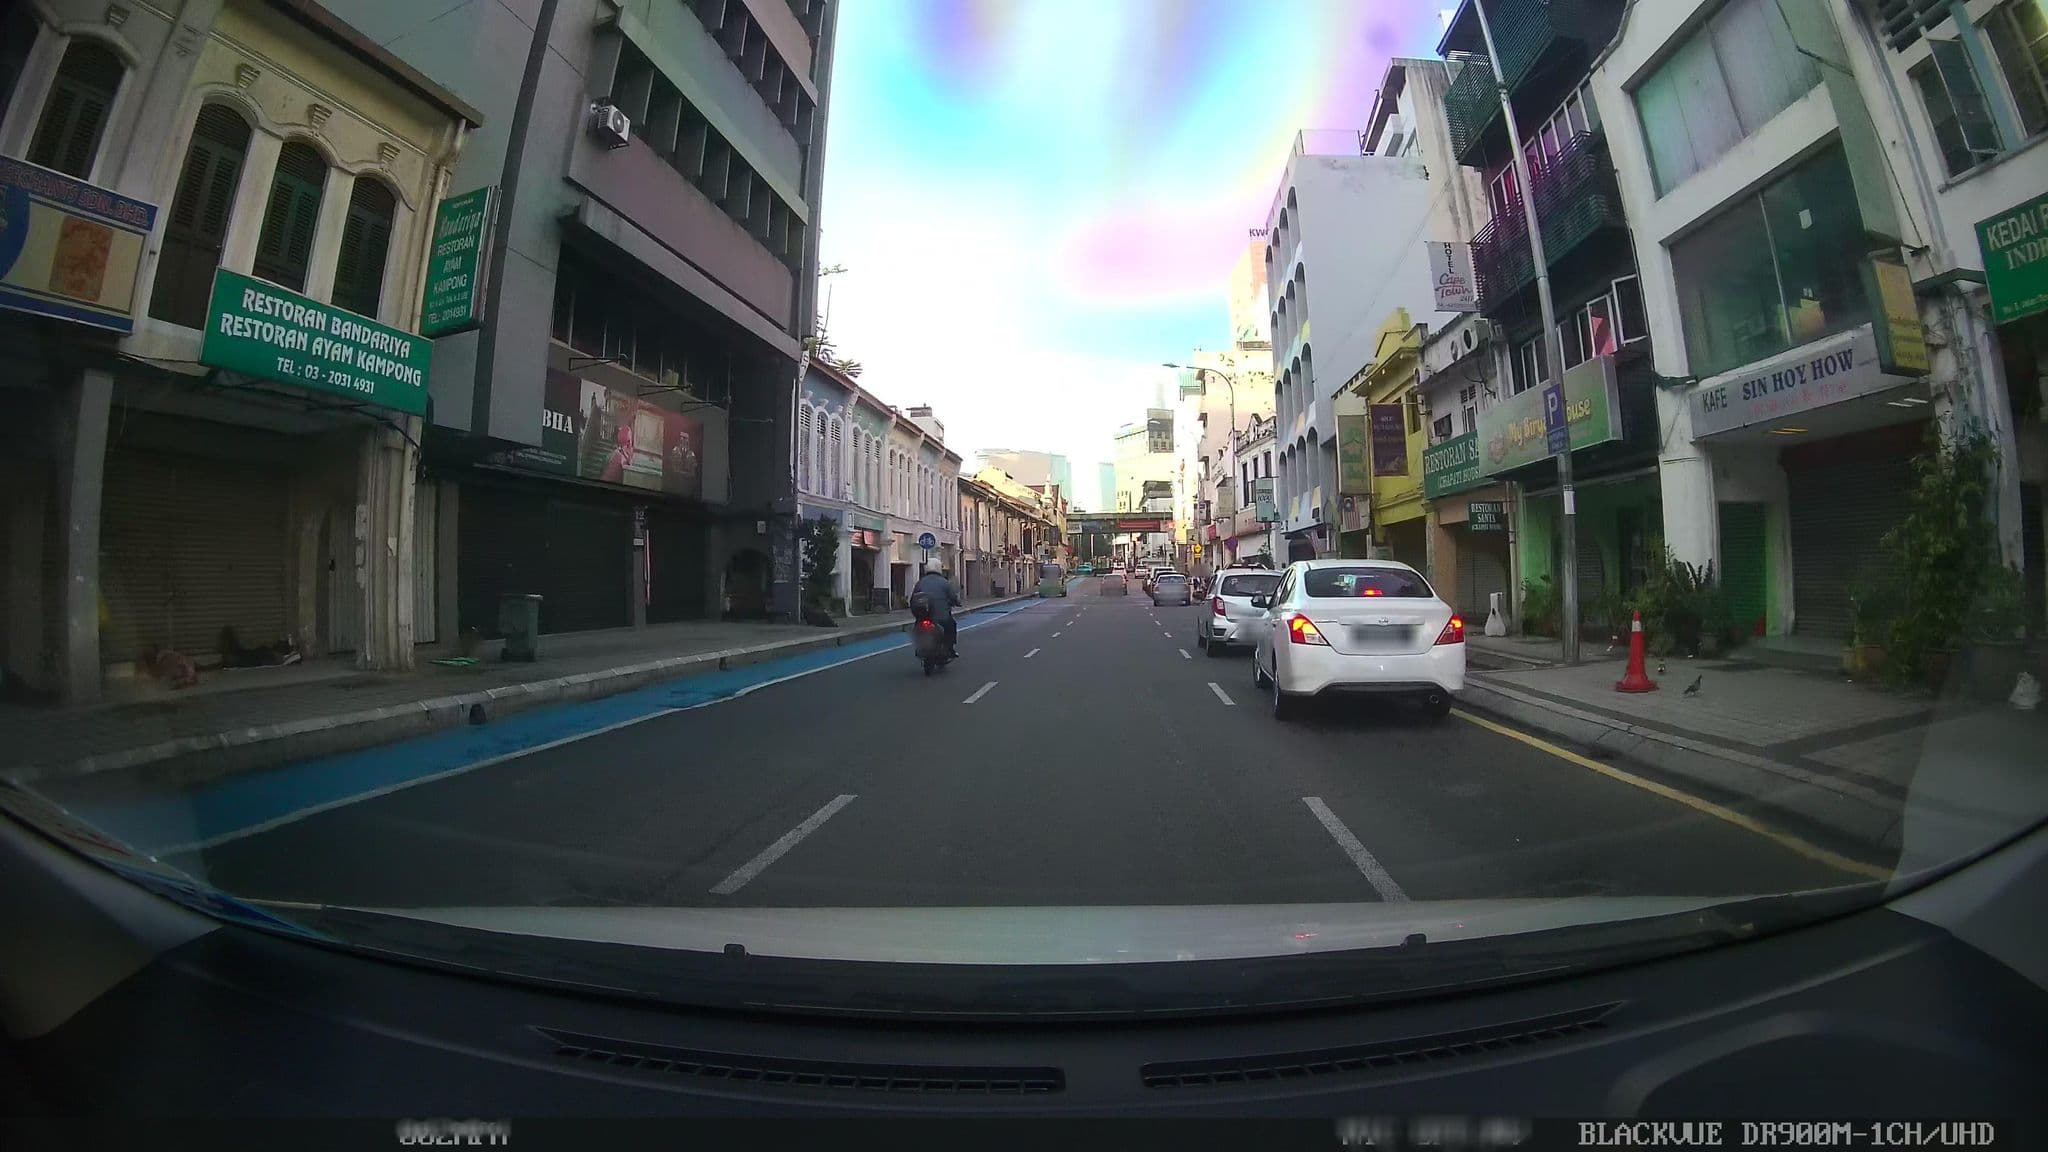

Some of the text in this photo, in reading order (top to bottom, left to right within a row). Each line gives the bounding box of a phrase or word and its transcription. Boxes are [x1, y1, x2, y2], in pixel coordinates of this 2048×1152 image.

[437, 235, 475, 257] RESTORAN
[1986, 208, 2039, 251] KEDAI
[1444, 242, 1455, 274] HOTEL
[432, 273, 468, 295] KAMPONG
[1439, 272, 1466, 286] Cape
[242, 288, 411, 359] RESTORAN BANDARIYA
[220, 312, 422, 388] RESTORAN AYAM KAMPONG
[304, 363, 320, 380] 03
[328, 370, 351, 387] 2031
[353, 376, 375, 394] 4931
[1702, 387, 1728, 414] KAFE
[1743, 376, 1768, 401] SIN
[1773, 363, 1807, 392] HOY
[1811, 348, 1854, 381] HOW
[1547, 391, 1559, 425] P
[1424, 442, 1467, 475] RESTORAN
